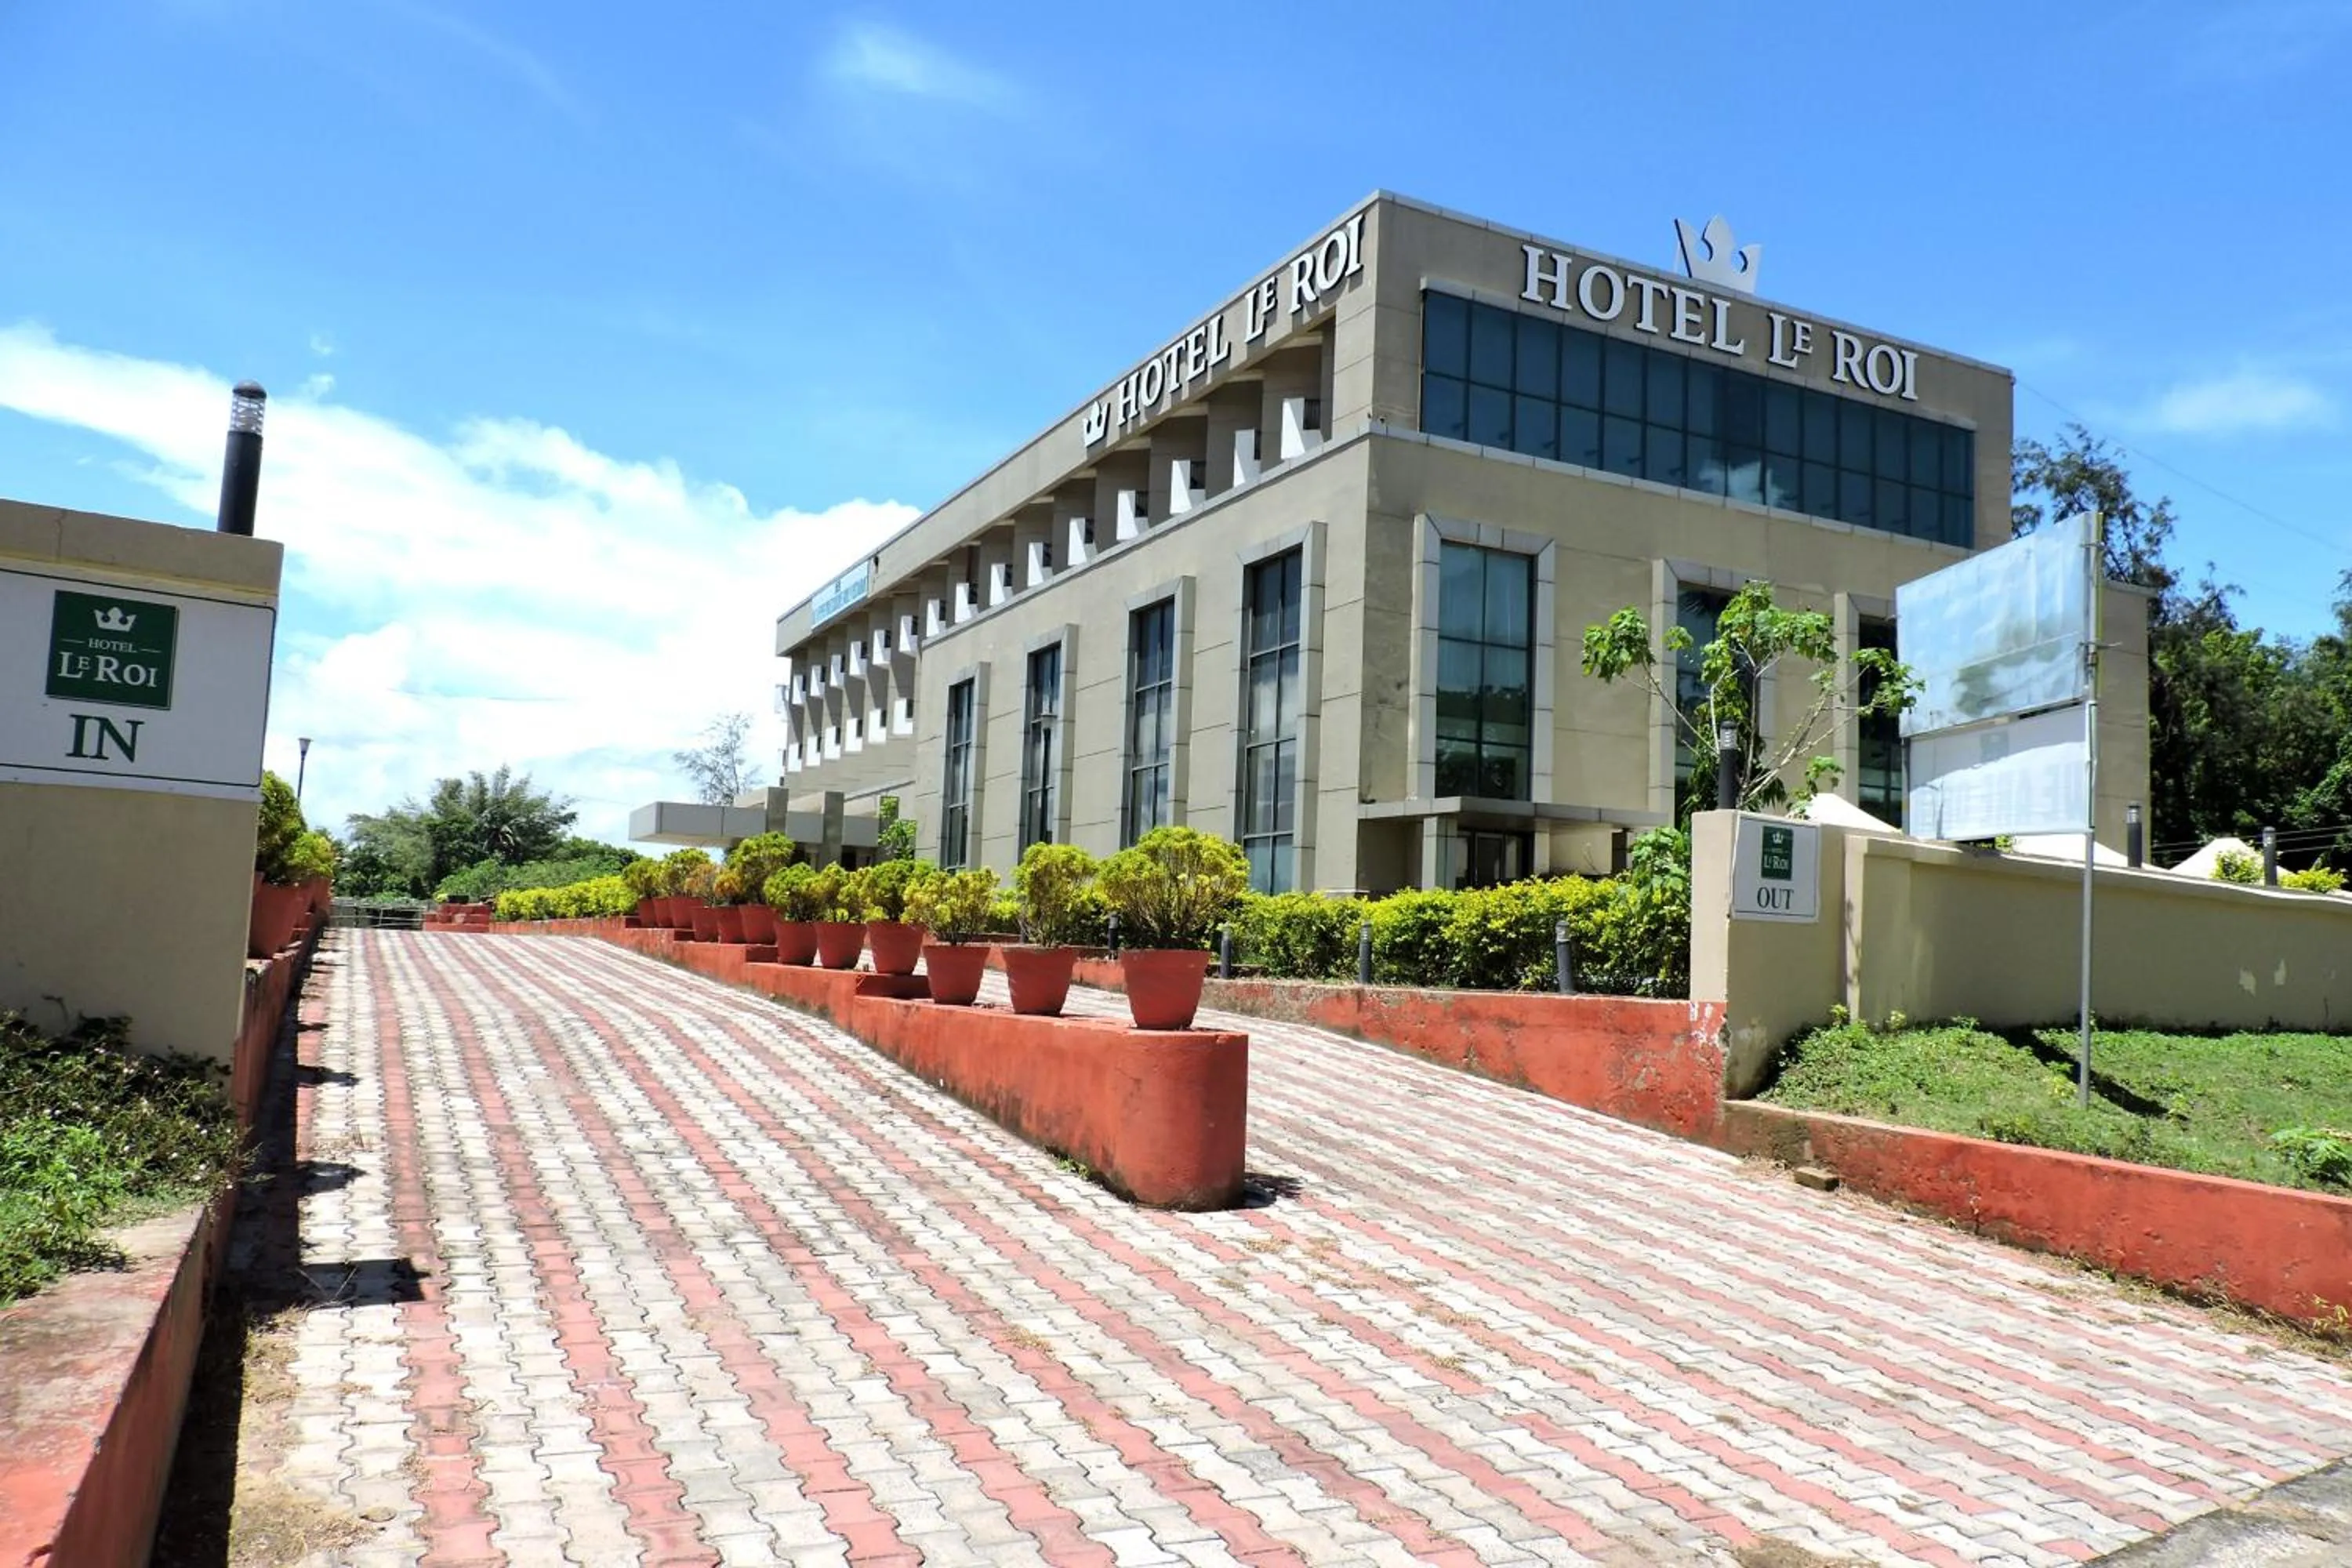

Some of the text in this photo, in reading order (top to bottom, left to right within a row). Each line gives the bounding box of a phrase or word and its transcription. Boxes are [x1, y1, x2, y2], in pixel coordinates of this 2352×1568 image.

[1116, 314, 1231, 426] HOTEL
[1288, 214, 1365, 314] ROI
[1520, 245, 1744, 356] HOTEL
[1831, 330, 1919, 401] ROI
[88, 637, 137, 653] HOTEL
[95, 655, 158, 688] ROI
[65, 713, 145, 763] IN
[1757, 886, 1794, 910] OUT
